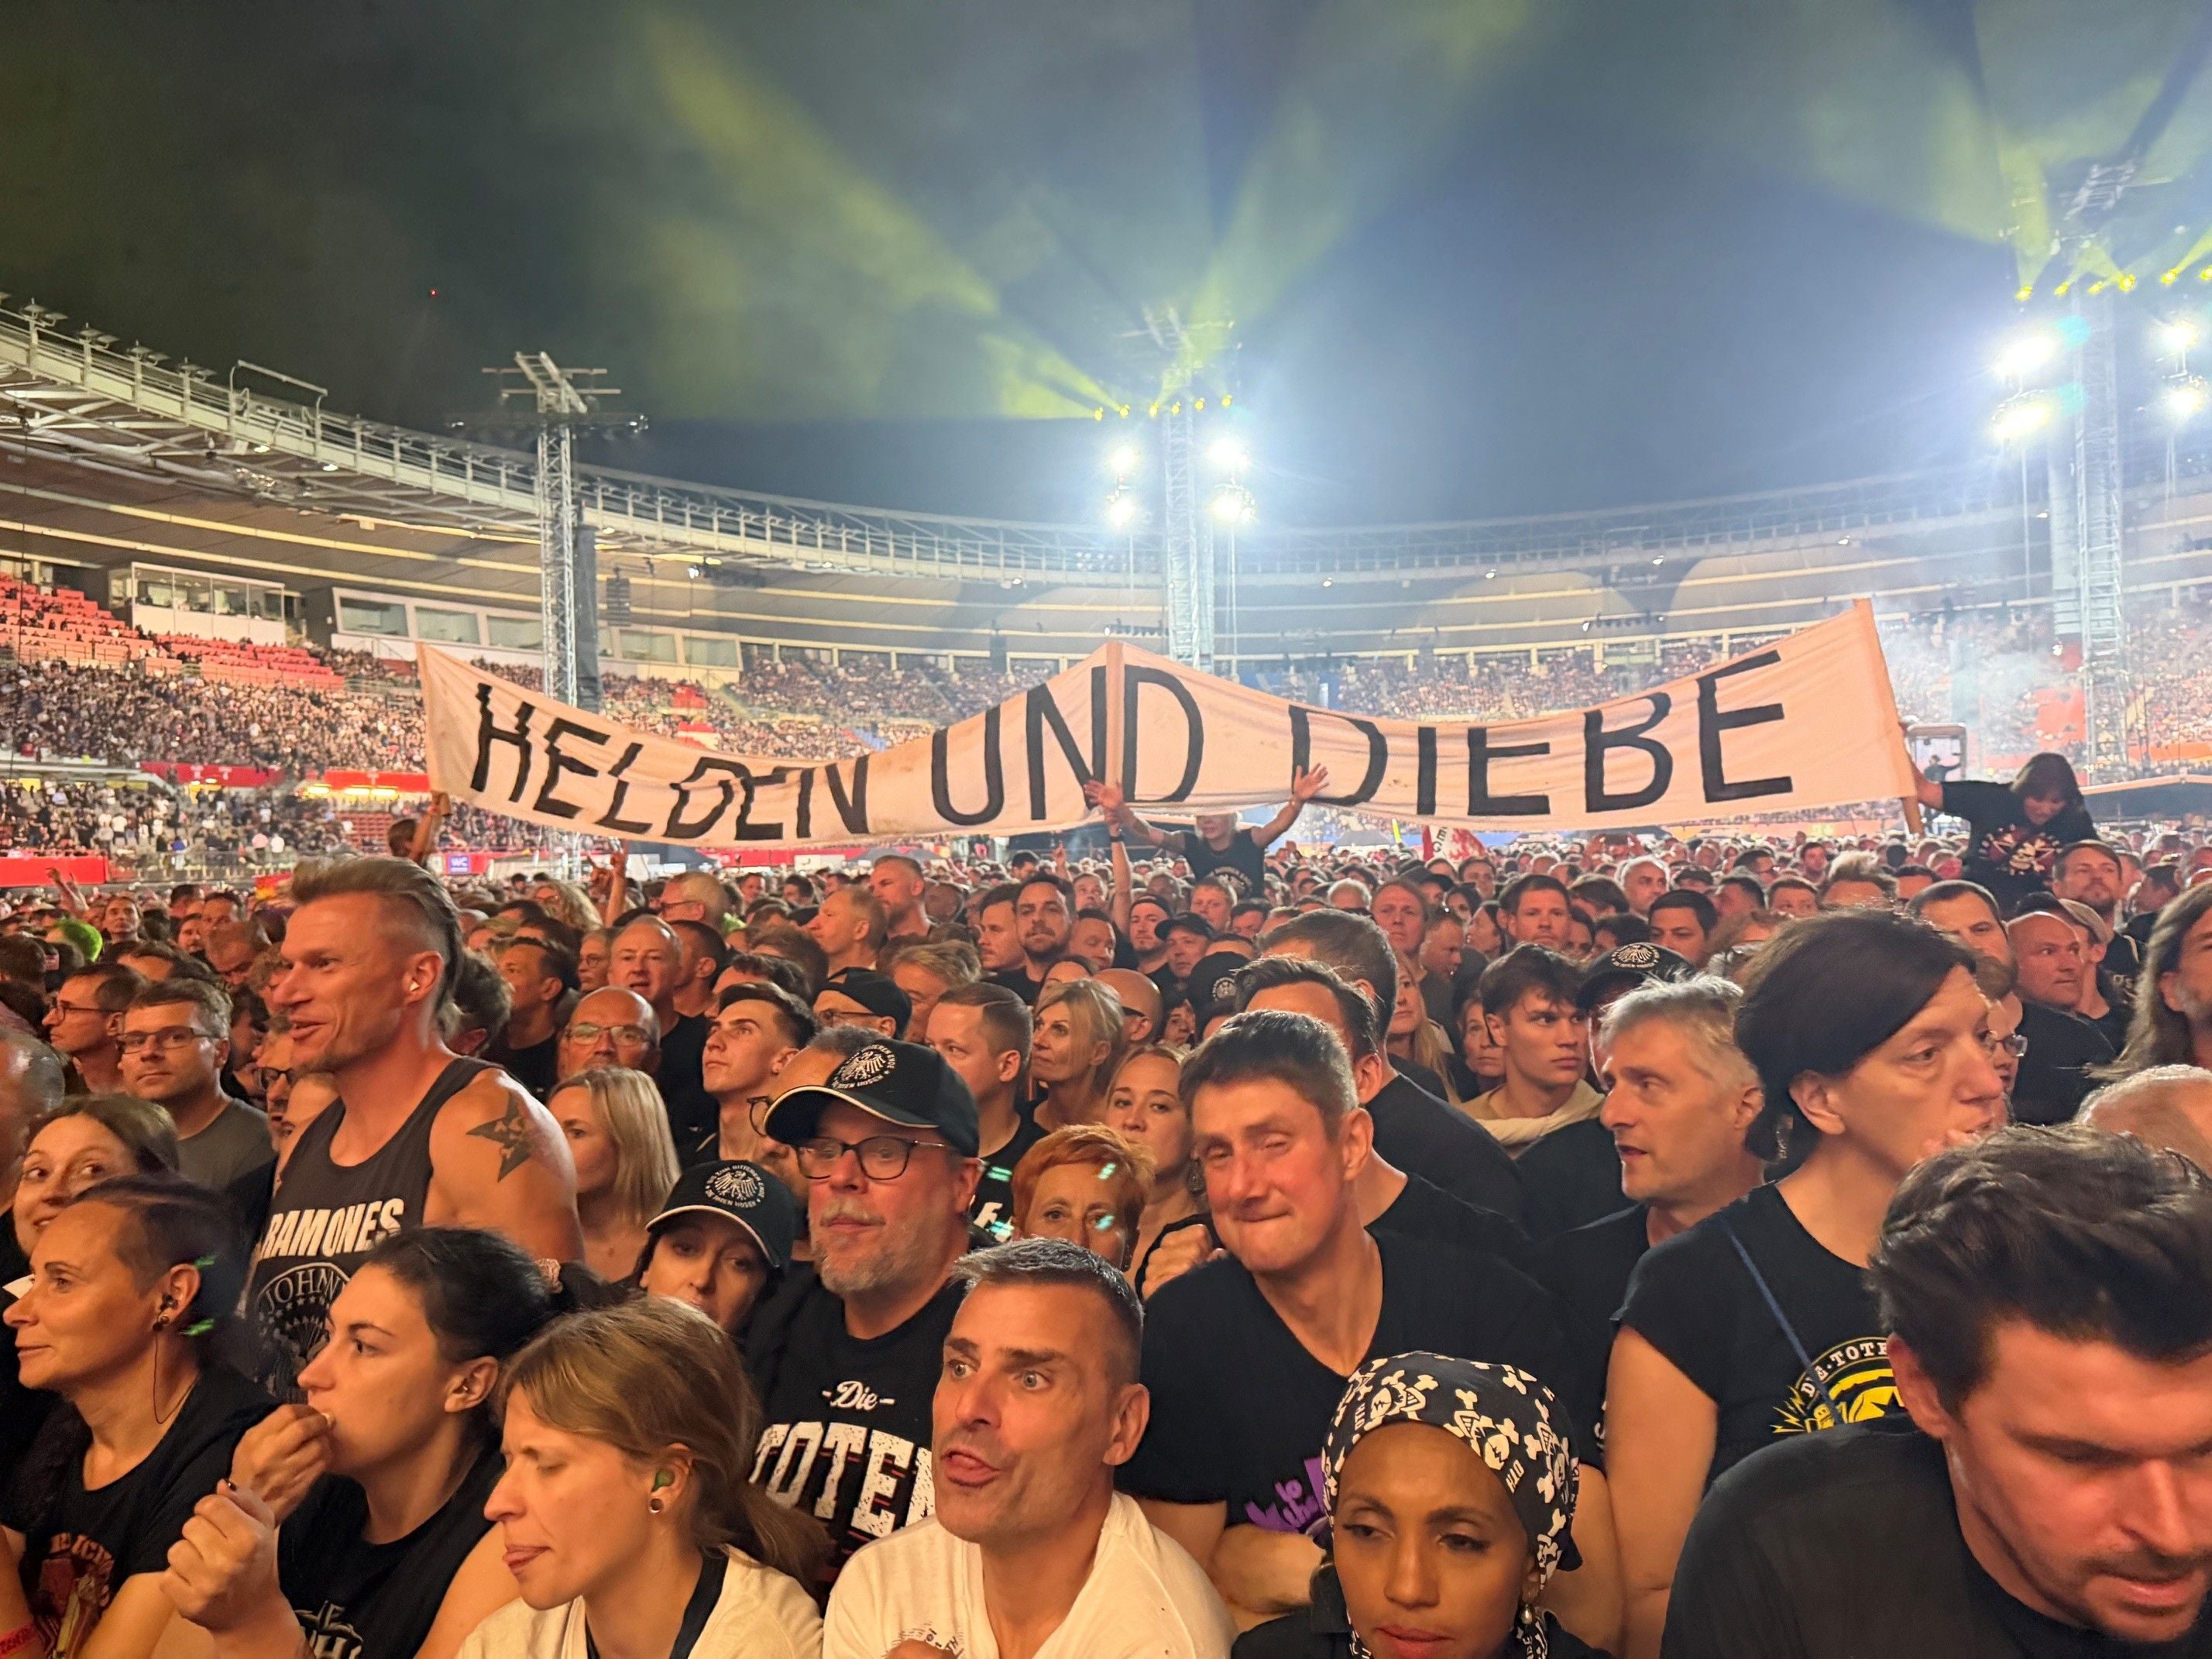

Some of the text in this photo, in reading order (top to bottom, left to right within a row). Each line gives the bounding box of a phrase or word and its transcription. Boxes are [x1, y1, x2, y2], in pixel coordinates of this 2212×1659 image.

[471, 649, 1793, 840] HELDEN UND DIEBE
[261, 1198, 404, 1259] RAMONES
